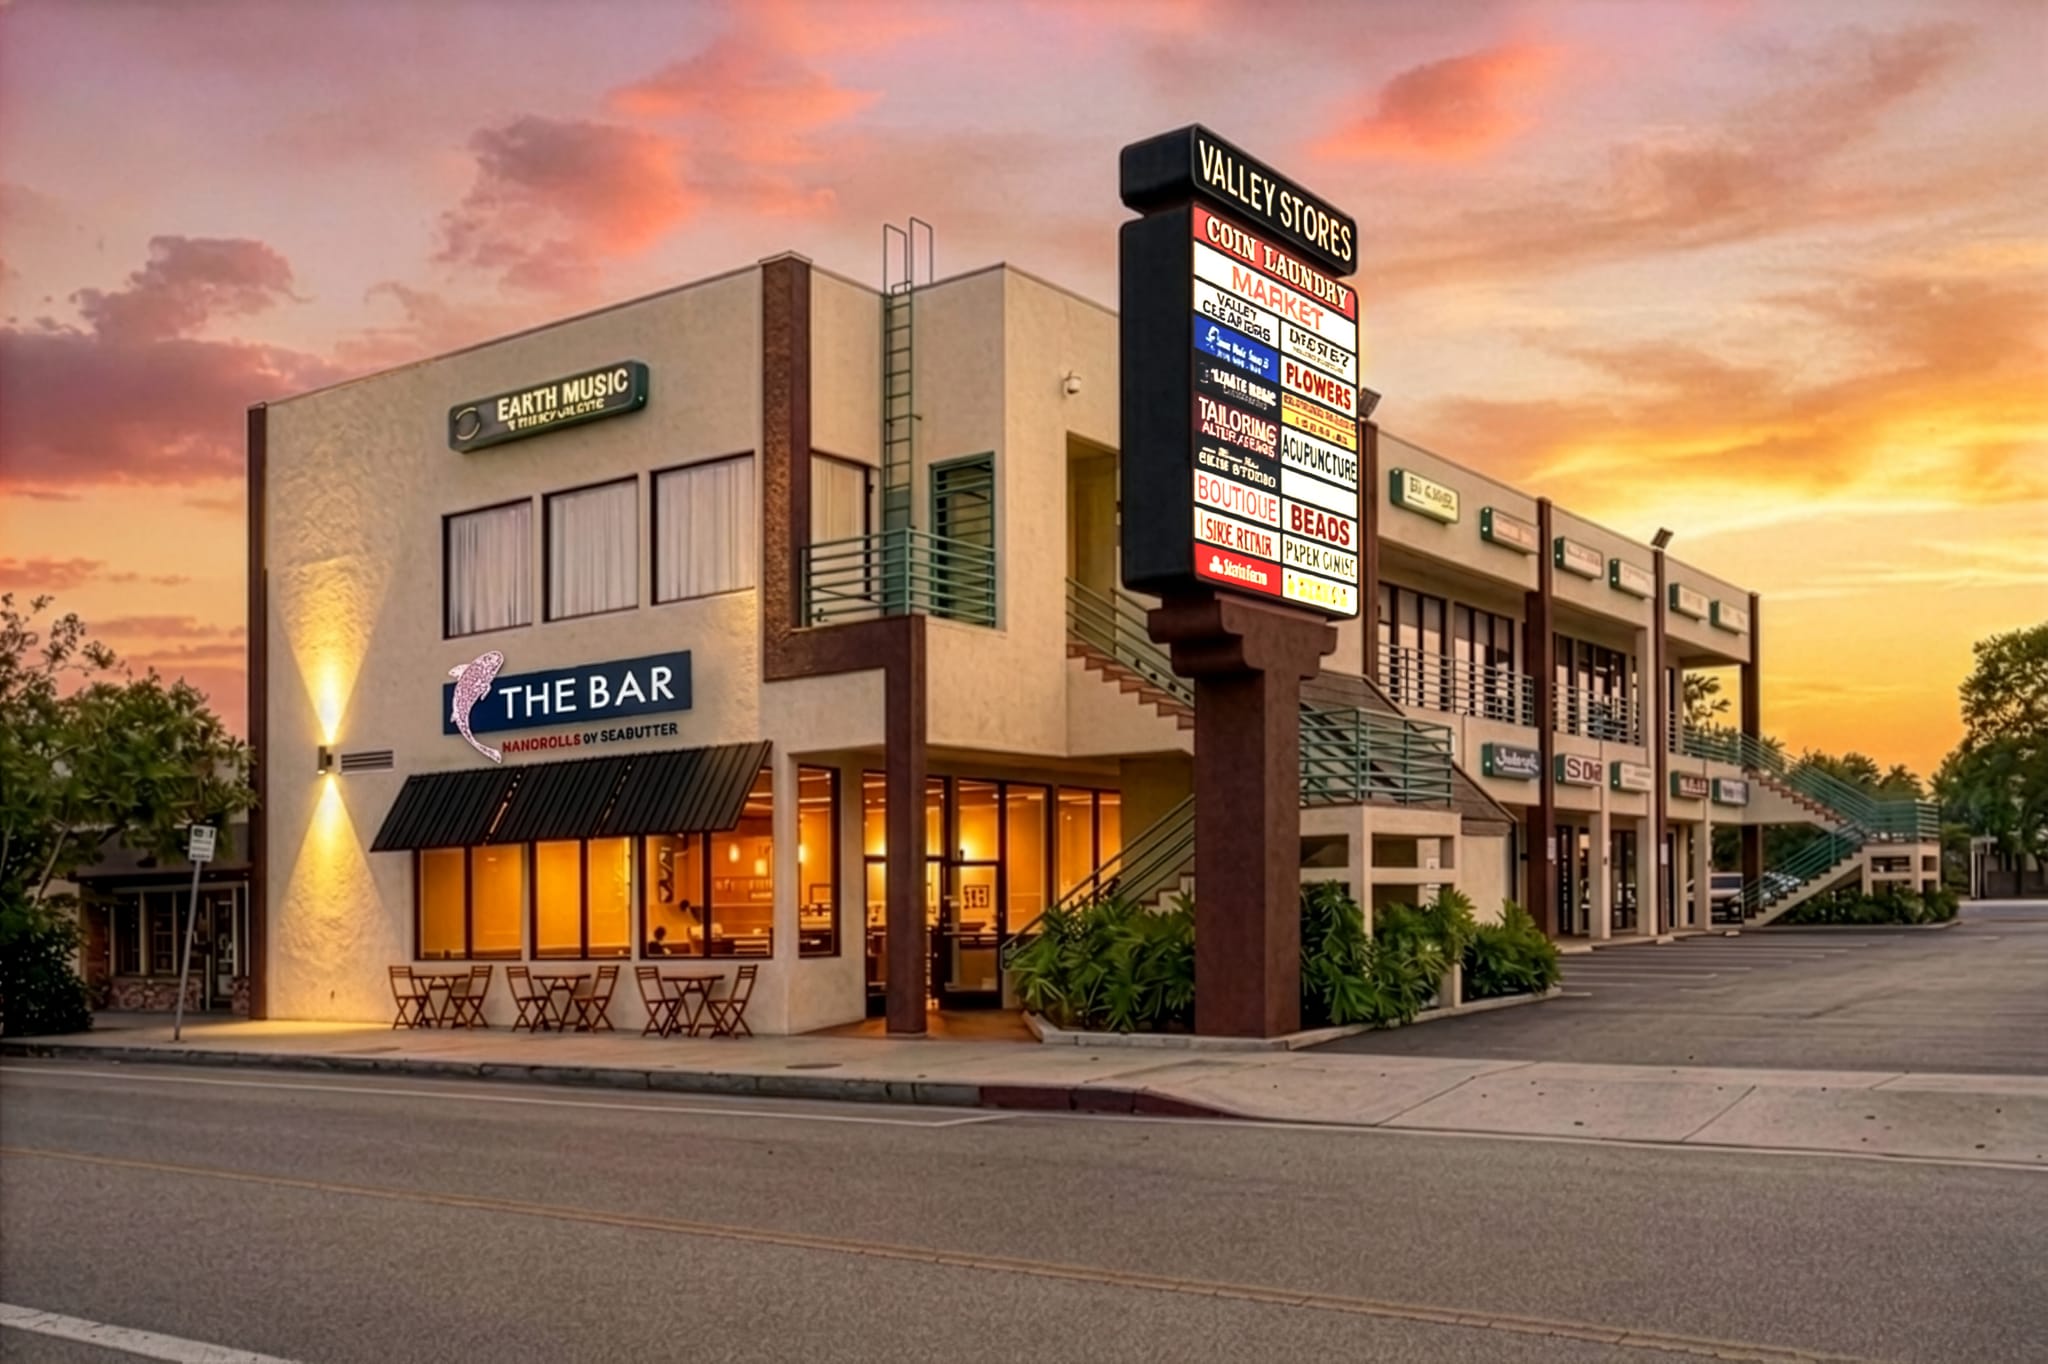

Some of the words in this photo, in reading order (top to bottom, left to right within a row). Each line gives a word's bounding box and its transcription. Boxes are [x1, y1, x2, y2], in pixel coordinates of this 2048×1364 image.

[1198, 139, 1276, 217] VALLEY
[1279, 191, 1352, 262] STORES
[1206, 215, 1257, 261] COIN
[1263, 244, 1349, 309] LAUNDRY
[1232, 266, 1324, 330] MARKET
[497, 386, 559, 422] EARTH
[563, 368, 629, 404] MUSIC
[1198, 396, 1277, 446] TAILORING
[1291, 504, 1350, 546] BEADS
[499, 678, 577, 720] THE
[589, 666, 675, 709] BAR
[600, 723, 678, 743] SEABUTTER
